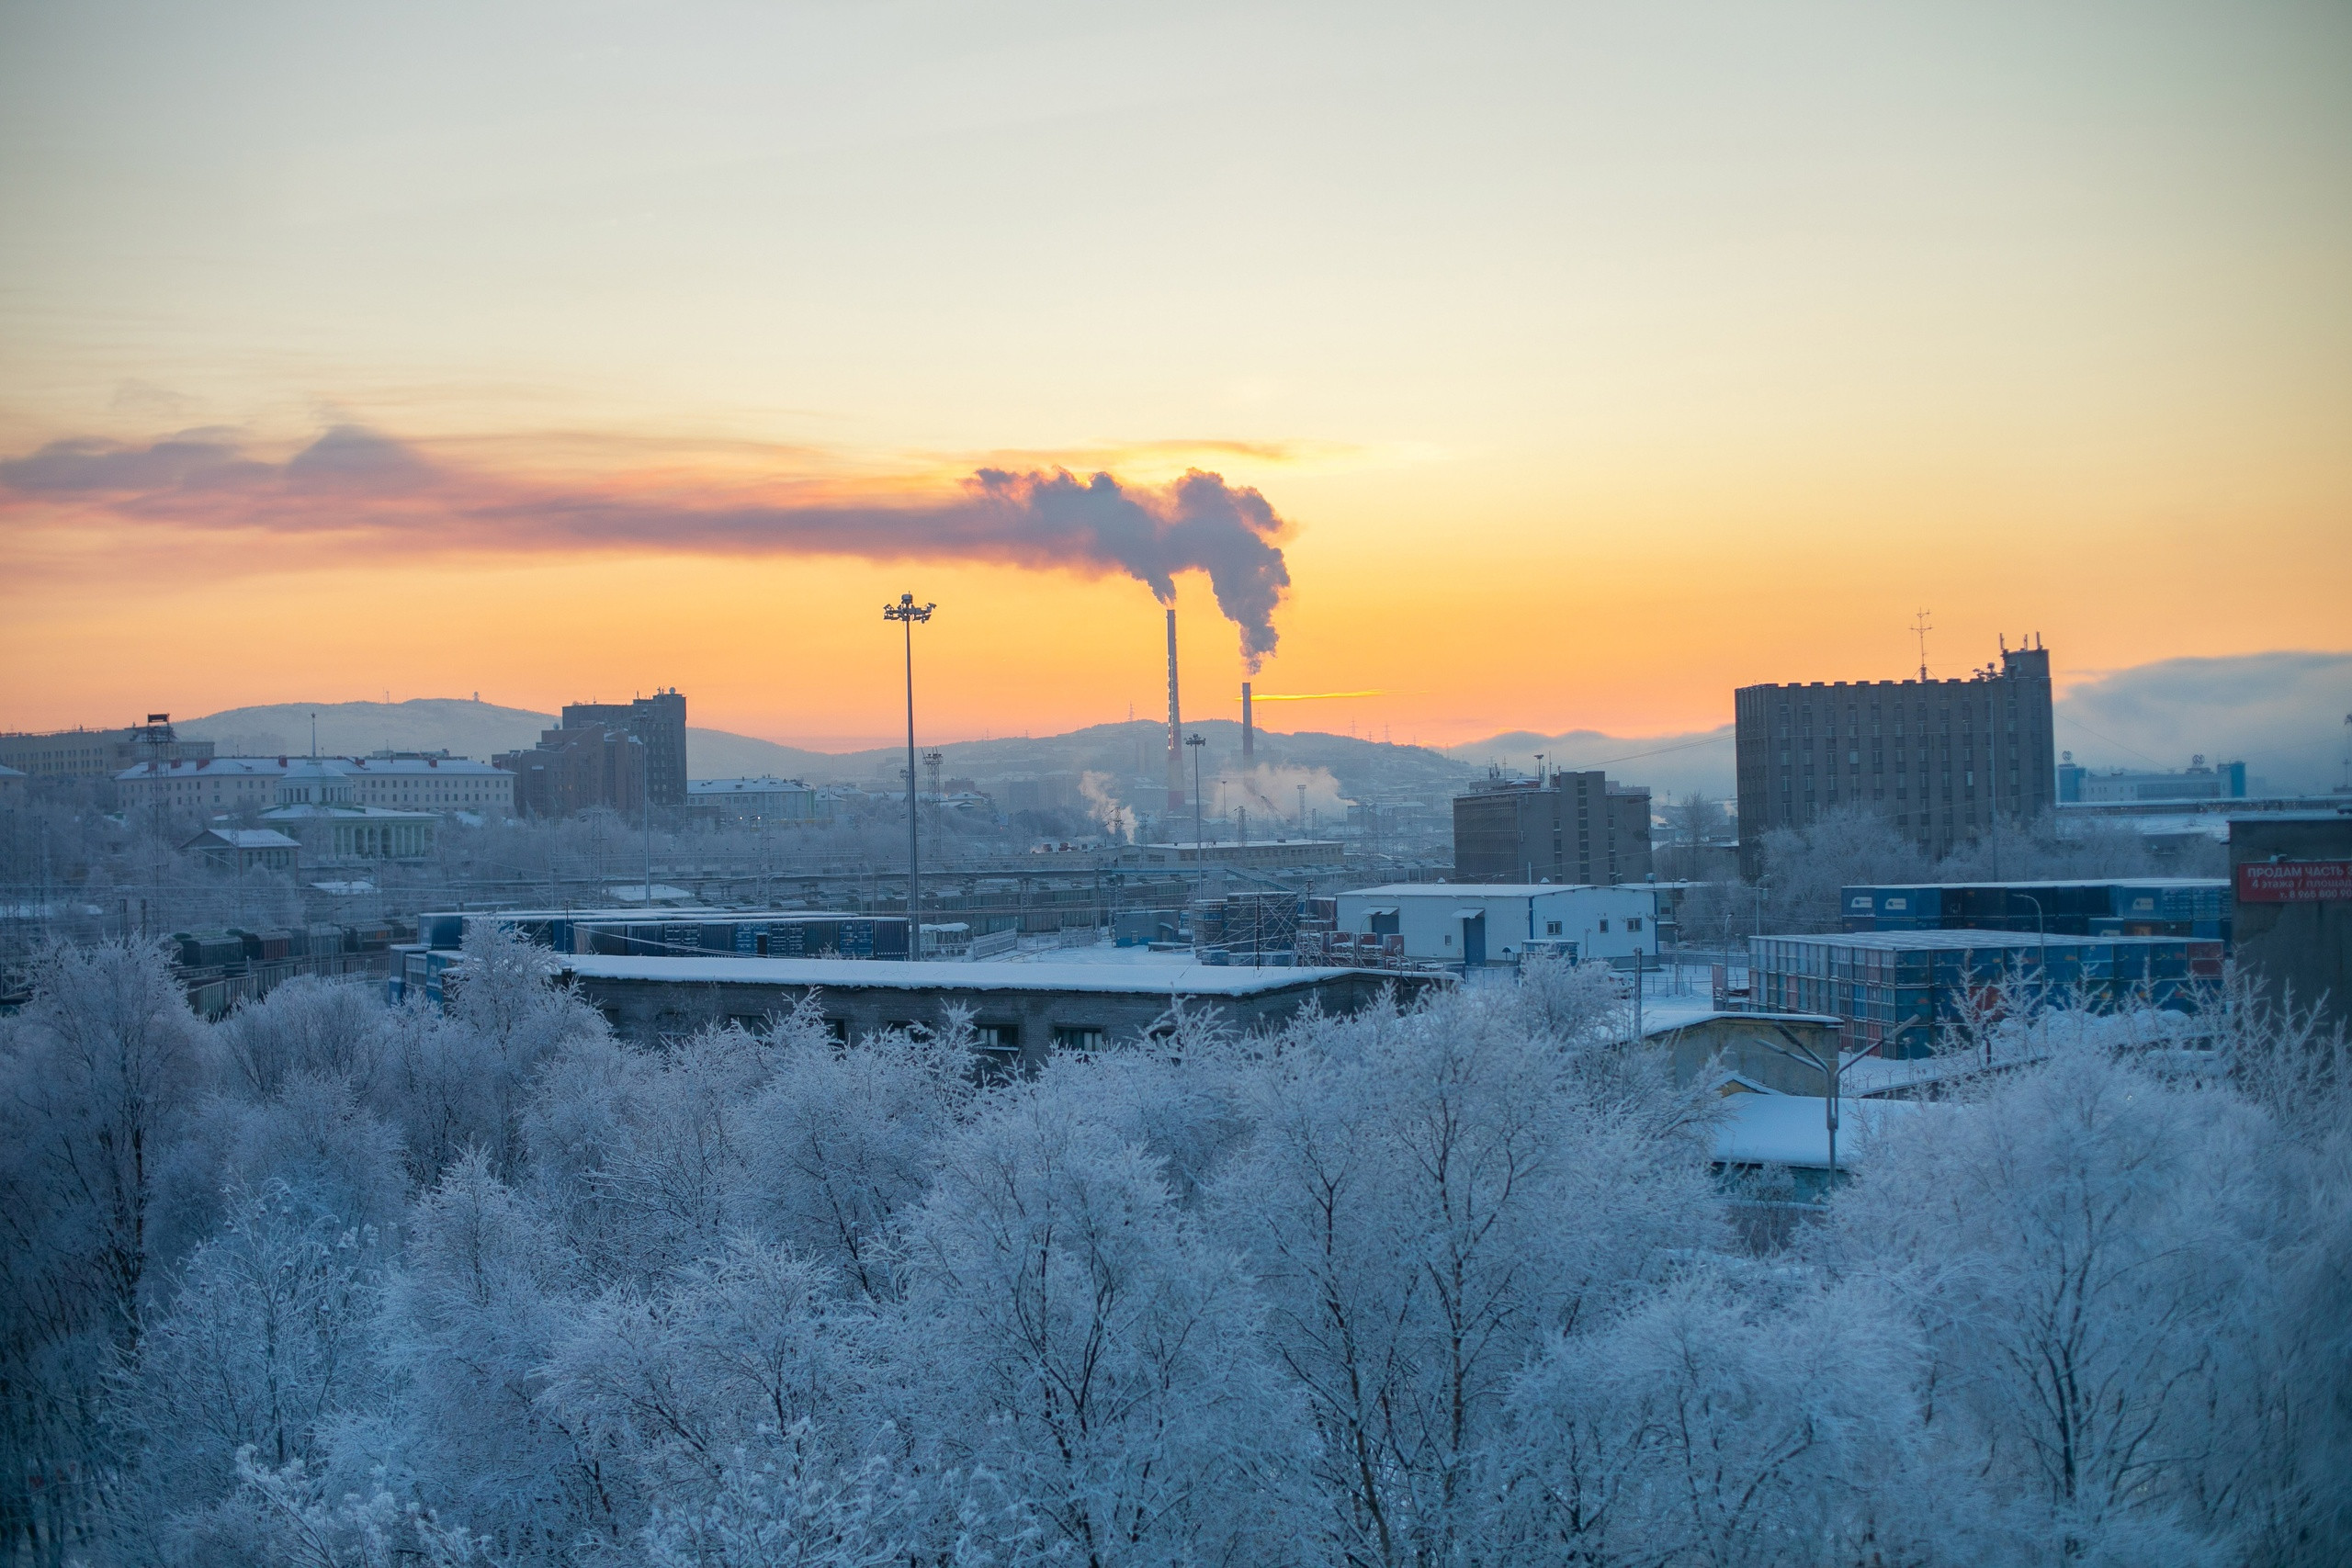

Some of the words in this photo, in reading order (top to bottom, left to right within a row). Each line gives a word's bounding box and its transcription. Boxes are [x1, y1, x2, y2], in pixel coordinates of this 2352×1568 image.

[2247, 867, 2302, 878] ПРОДАМ
[2304, 866, 2344, 876] ЧАСТЬ
[2252, 879, 2258, 889] 4
[2262, 880, 2295, 889] этажа
[2289, 890, 2295, 898] 8
[2319, 889, 2337, 898] 800
